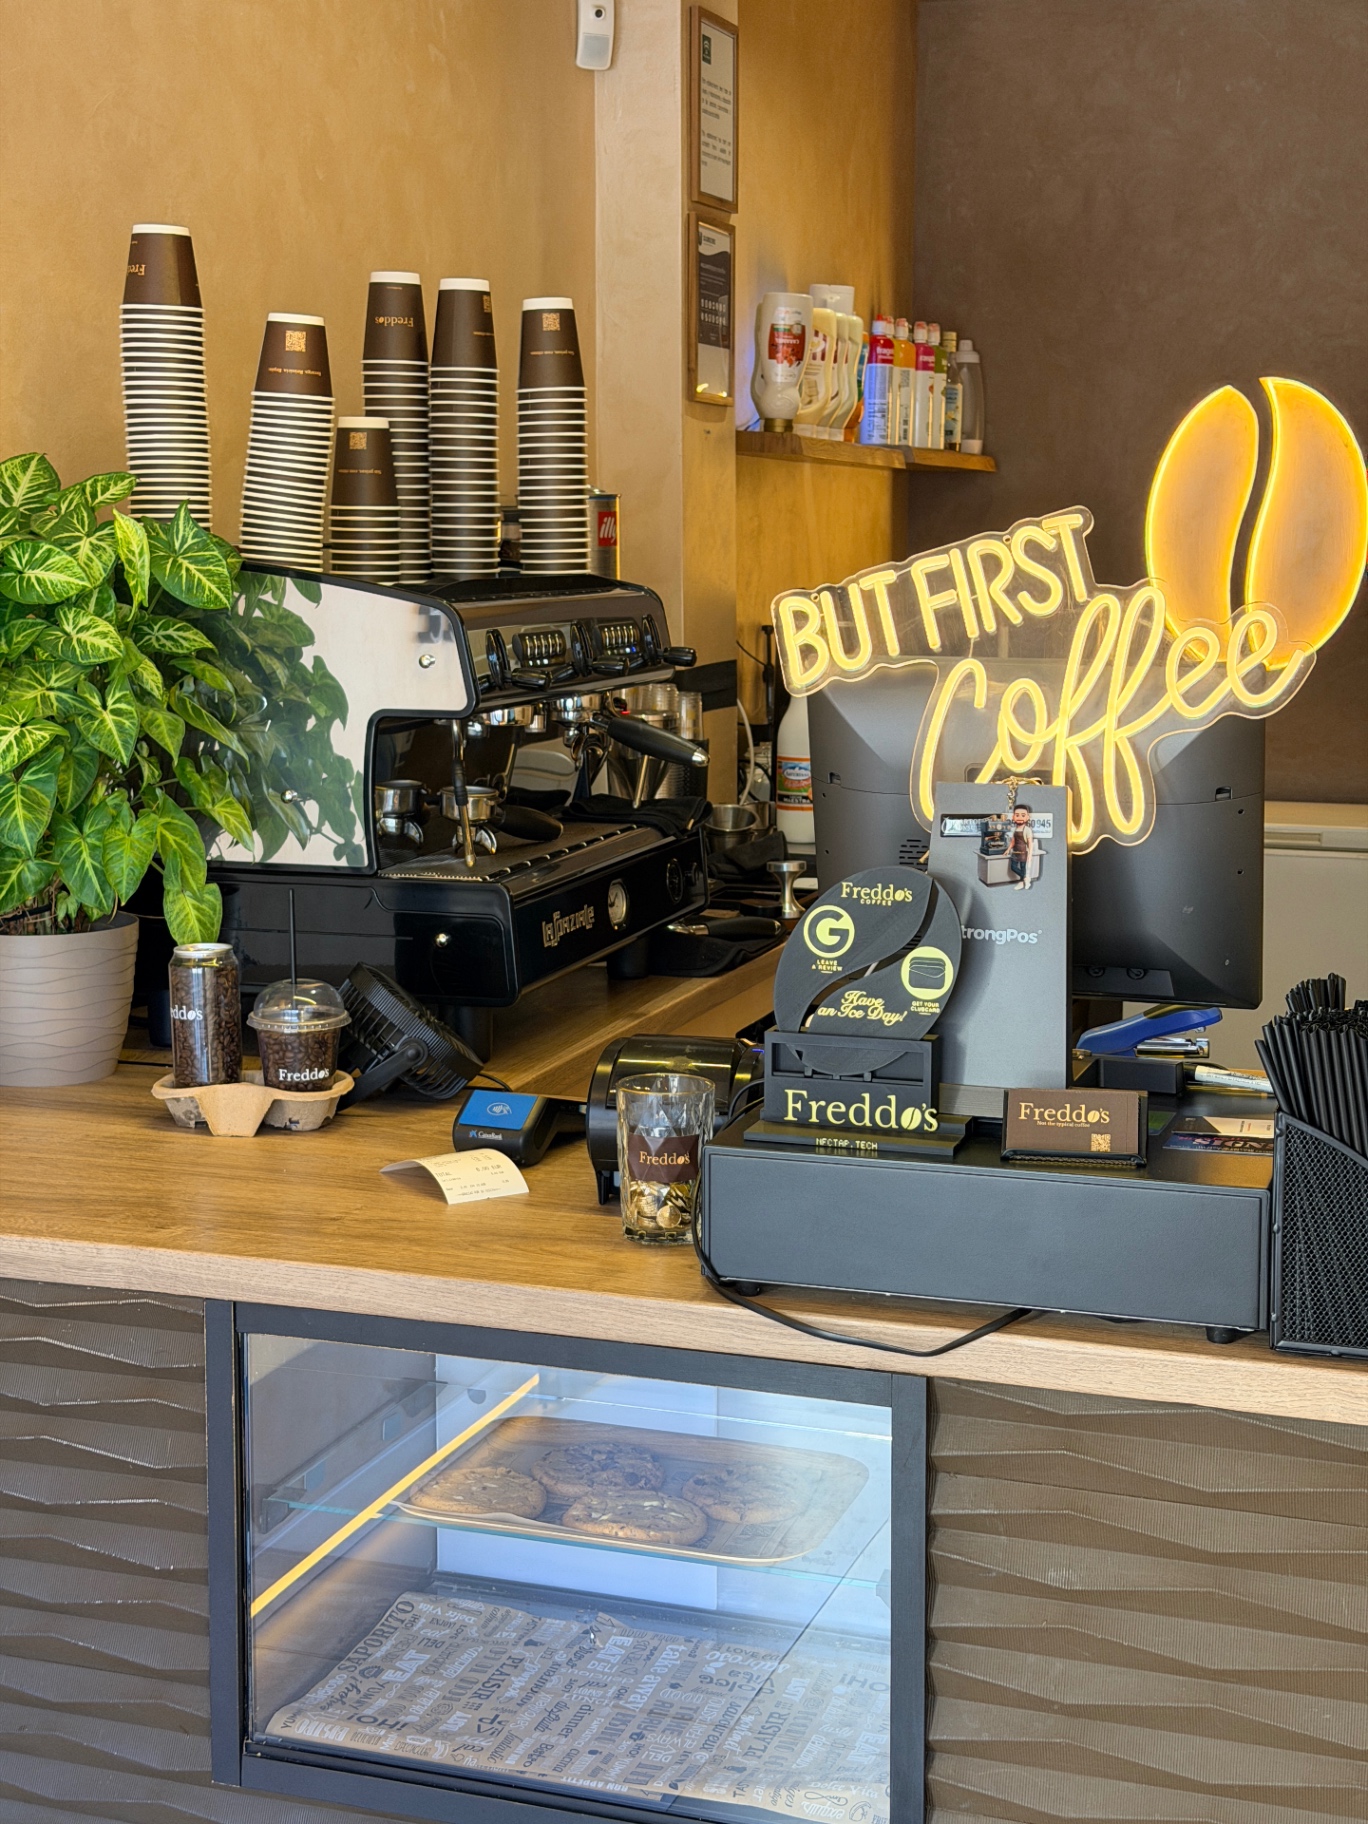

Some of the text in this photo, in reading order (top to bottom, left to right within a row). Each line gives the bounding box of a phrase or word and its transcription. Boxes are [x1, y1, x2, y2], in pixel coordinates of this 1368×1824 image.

[600, 516, 616, 544] illy
[777, 512, 1087, 690] BUT FIRST
[918, 585, 1308, 844] Coffee
[840, 881, 913, 903] Freddo's
[860, 898, 893, 907] COFFEE
[817, 964, 843, 972] REVIEW
[841, 990, 884, 1008] Have
[910, 1005, 940, 1014] CLUBCARD
[817, 1002, 908, 1027] an Ice Day!
[278, 1067, 330, 1083] Freddo's
[783, 1088, 939, 1133] Freddo's
[1018, 1102, 1111, 1124] Freddo's
[1056, 1121, 1074, 1129] typical
[638, 1150, 692, 1166] Freddo's
[338, 1600, 417, 1672] SAPORITO
[417, 1637, 446, 1648] DELI
[437, 1643, 484, 1678] delicious
[593, 1635, 634, 1663] EAT
[649, 1643, 690, 1674] take
[726, 1645, 760, 1657] LOVE
[382, 1648, 432, 1682] EAT
[585, 1660, 620, 1672] DELI
[705, 1650, 791, 1674] sabroso
[469, 1655, 523, 1701] PLAISIR
[555, 1667, 636, 1684] delicious
[615, 1673, 663, 1712] away
[556, 1703, 596, 1738] dinner
[696, 1701, 745, 1752] savoureux
[484, 1729, 529, 1764] fantastic
[645, 1732, 696, 1748] ALWAYS
[740, 1711, 790, 1759] PLAISIR
[844, 1731, 887, 1764] EAT
[450, 1742, 485, 1755] eat
[551, 1748, 582, 1773] cucina
[641, 1751, 672, 1763] DELI
[601, 1756, 632, 1781] YUMMY
